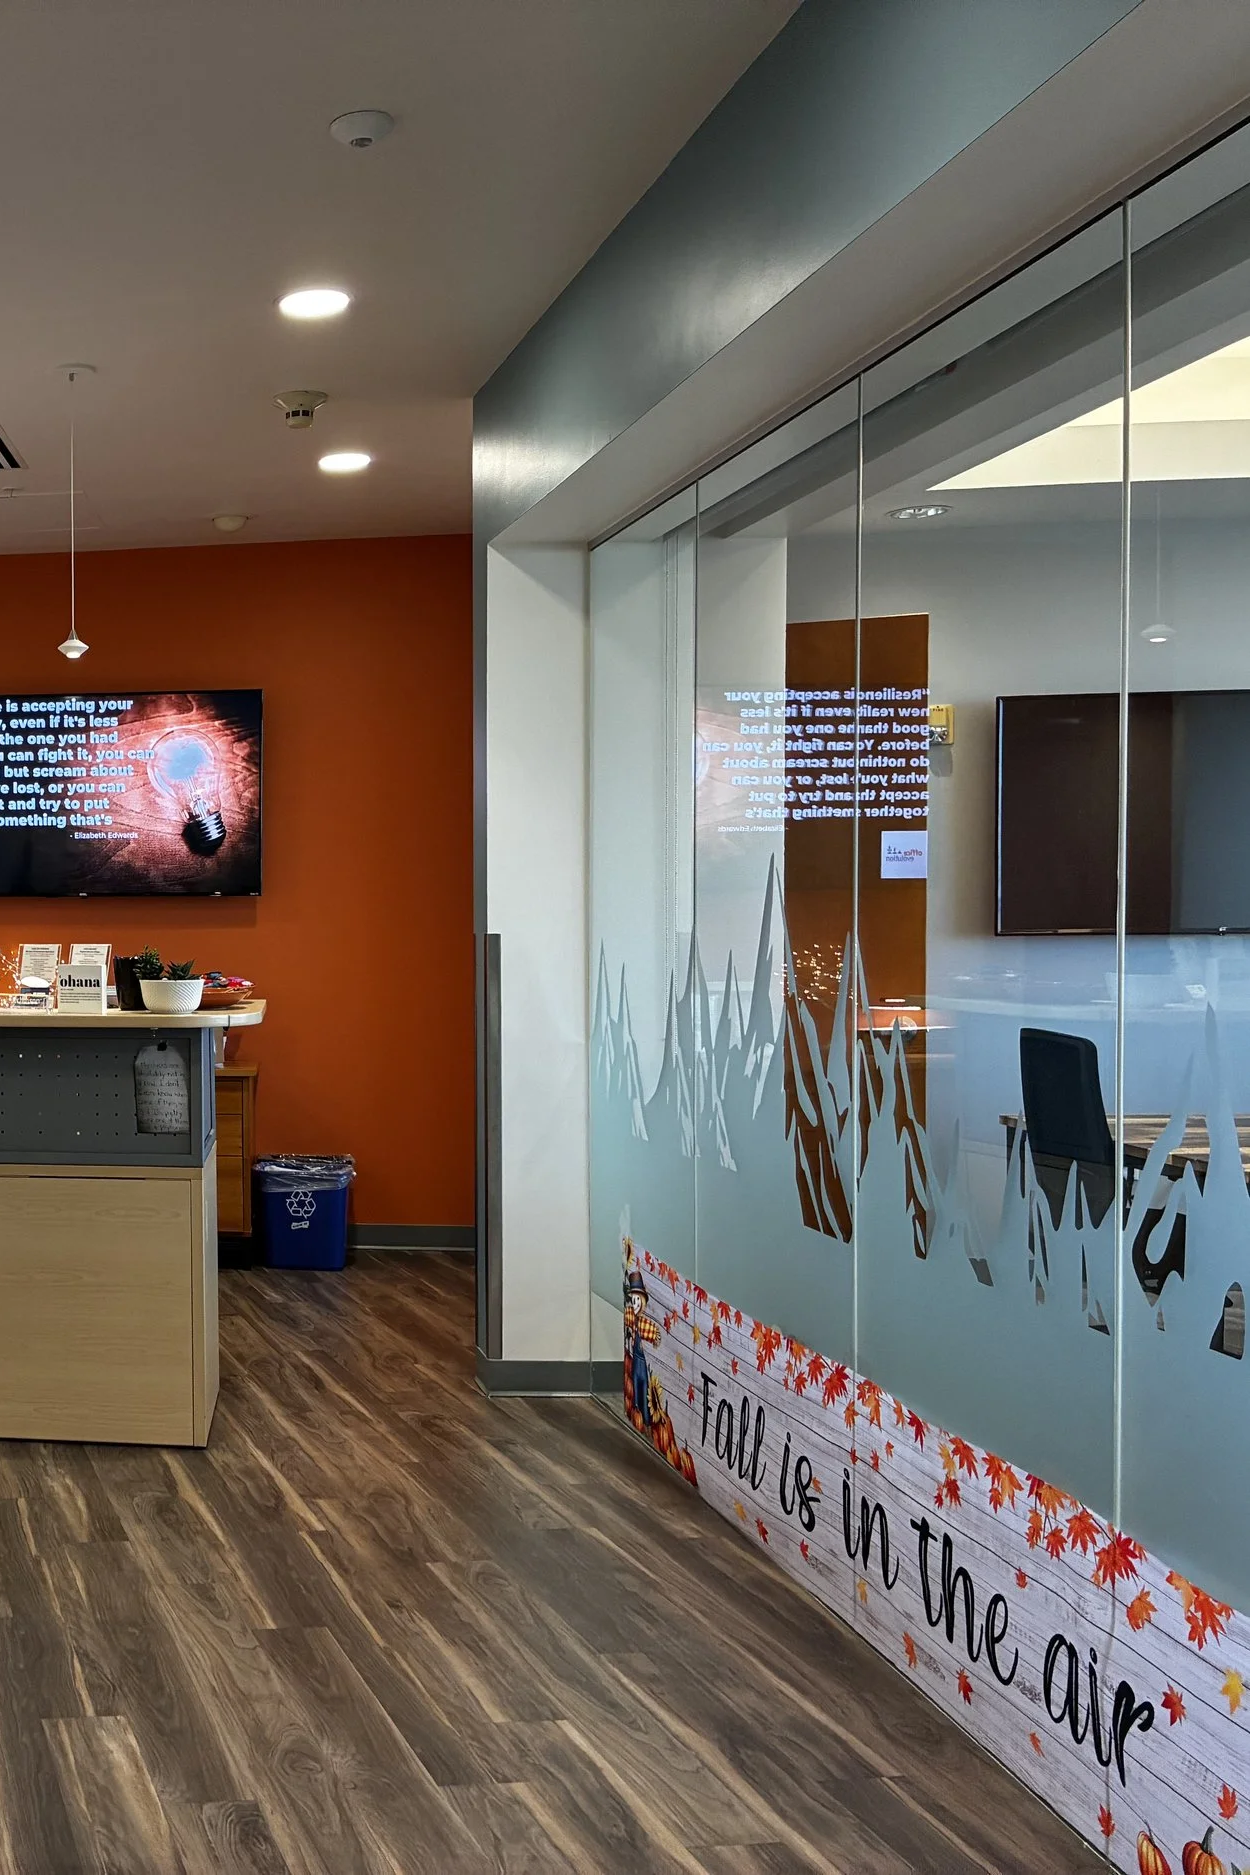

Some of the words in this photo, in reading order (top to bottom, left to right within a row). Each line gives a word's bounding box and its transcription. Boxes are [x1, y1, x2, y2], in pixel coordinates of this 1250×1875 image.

[5, 699, 18, 713] is
[21, 698, 95, 714] accepting
[98, 699, 134, 713] your
[9, 718, 46, 729] even
[49, 714, 61, 728] if
[63, 714, 86, 728] it's
[89, 714, 119, 728] less
[26, 734, 55, 745] one
[58, 734, 86, 747] you
[89, 731, 118, 744] had
[7, 751, 34, 762] can
[37, 747, 74, 764] fight
[77, 747, 93, 762] it,
[95, 749, 124, 763] you
[127, 749, 155, 760] can
[3, 765, 30, 778] but
[32, 766, 87, 777] scream
[90, 763, 134, 777] about
[12, 781, 45, 796] lost,
[48, 783, 64, 794] or
[67, 783, 95, 796] you
[98, 782, 126, 794] can
[8, 797, 36, 810] and
[39, 798, 61, 813] try
[64, 798, 81, 810] to
[83, 798, 110, 812] put
[69, 813, 113, 826] that's
[107, 831, 139, 839] Edwards
[700, 1370, 766, 1492] Fall
[779, 1431, 821, 1533] is
[842, 1467, 899, 1591] in
[910, 1516, 1018, 1687] the
[1043, 1633, 1156, 1788] air
